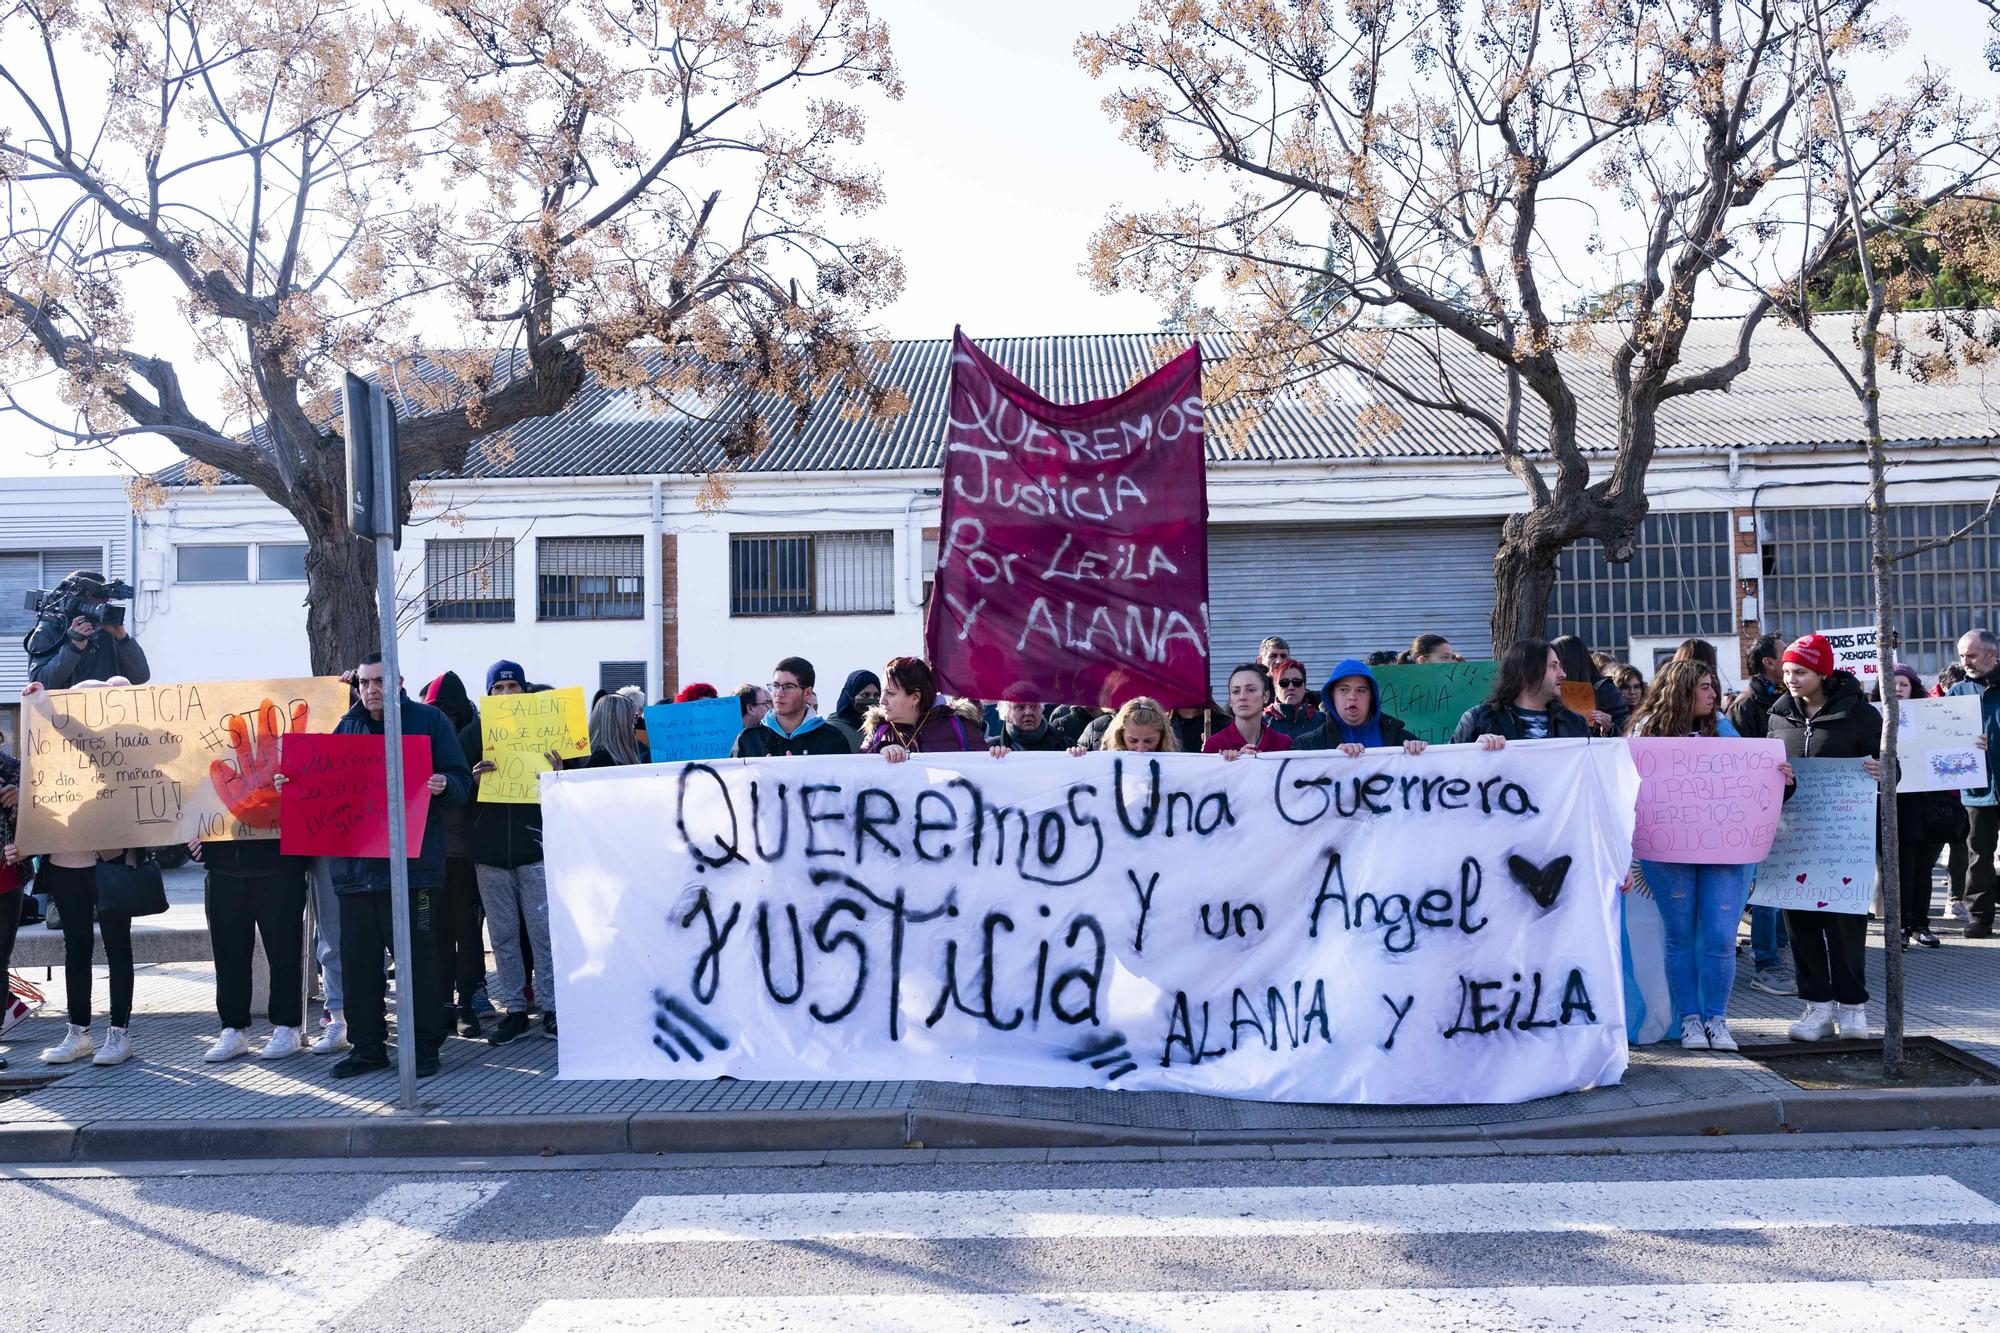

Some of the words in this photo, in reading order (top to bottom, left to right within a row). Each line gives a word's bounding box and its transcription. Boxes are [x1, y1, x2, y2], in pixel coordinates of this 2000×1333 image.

[1380, 682, 1453, 720] ALANA
[27, 729, 51, 757] No
[62, 732, 107, 753] mires
[114, 731, 152, 748] hacia
[159, 730, 184, 745] otro
[488, 727, 509, 743] NO
[513, 727, 530, 740] SE
[536, 723, 570, 738] CALLA
[30, 769, 46, 787] el
[90, 769, 107, 784] de
[116, 767, 164, 783] mañana
[489, 755, 525, 781] NO
[1672, 748, 1775, 777] BUSCAMOS
[95, 787, 119, 800] ser
[1275, 759, 1540, 826] Guerrera
[197, 811, 225, 840] NO
[1201, 901, 1265, 939] un
[1309, 851, 1488, 953] Angel
[1160, 979, 1332, 1067] ALANA
